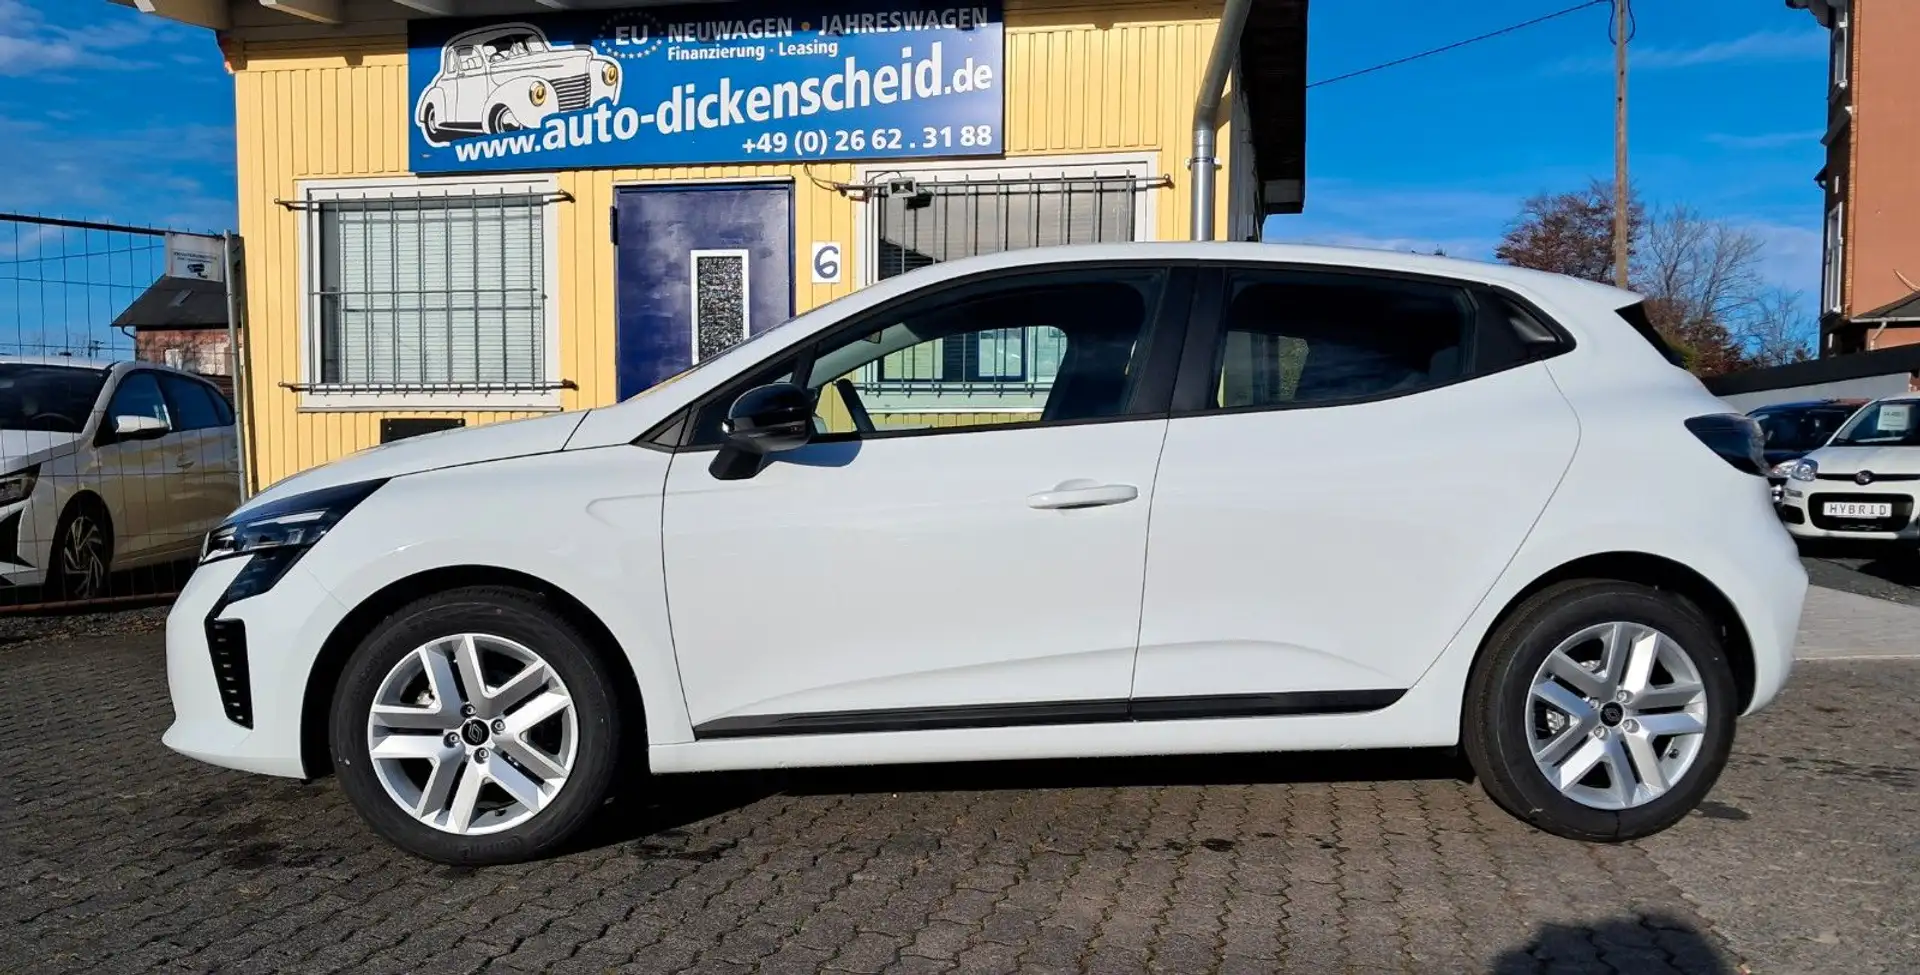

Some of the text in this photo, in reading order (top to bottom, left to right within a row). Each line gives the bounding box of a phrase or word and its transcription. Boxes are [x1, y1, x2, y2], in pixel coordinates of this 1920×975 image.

[615, 7, 987, 46] EU NEUWAGEN JAHRESWAGEN
[668, 40, 838, 61] Finanzierung Leasing
[455, 41, 993, 162] www.auto-dickenscheid.de
[742, 132, 788, 153] +49
[794, 130, 827, 155] (0)
[835, 129, 866, 151] 26
[871, 128, 902, 150] 62
[922, 126, 952, 148] 31
[960, 125, 992, 147] 88
[814, 245, 839, 279] 6
[1829, 503, 1887, 516] HYBRID
